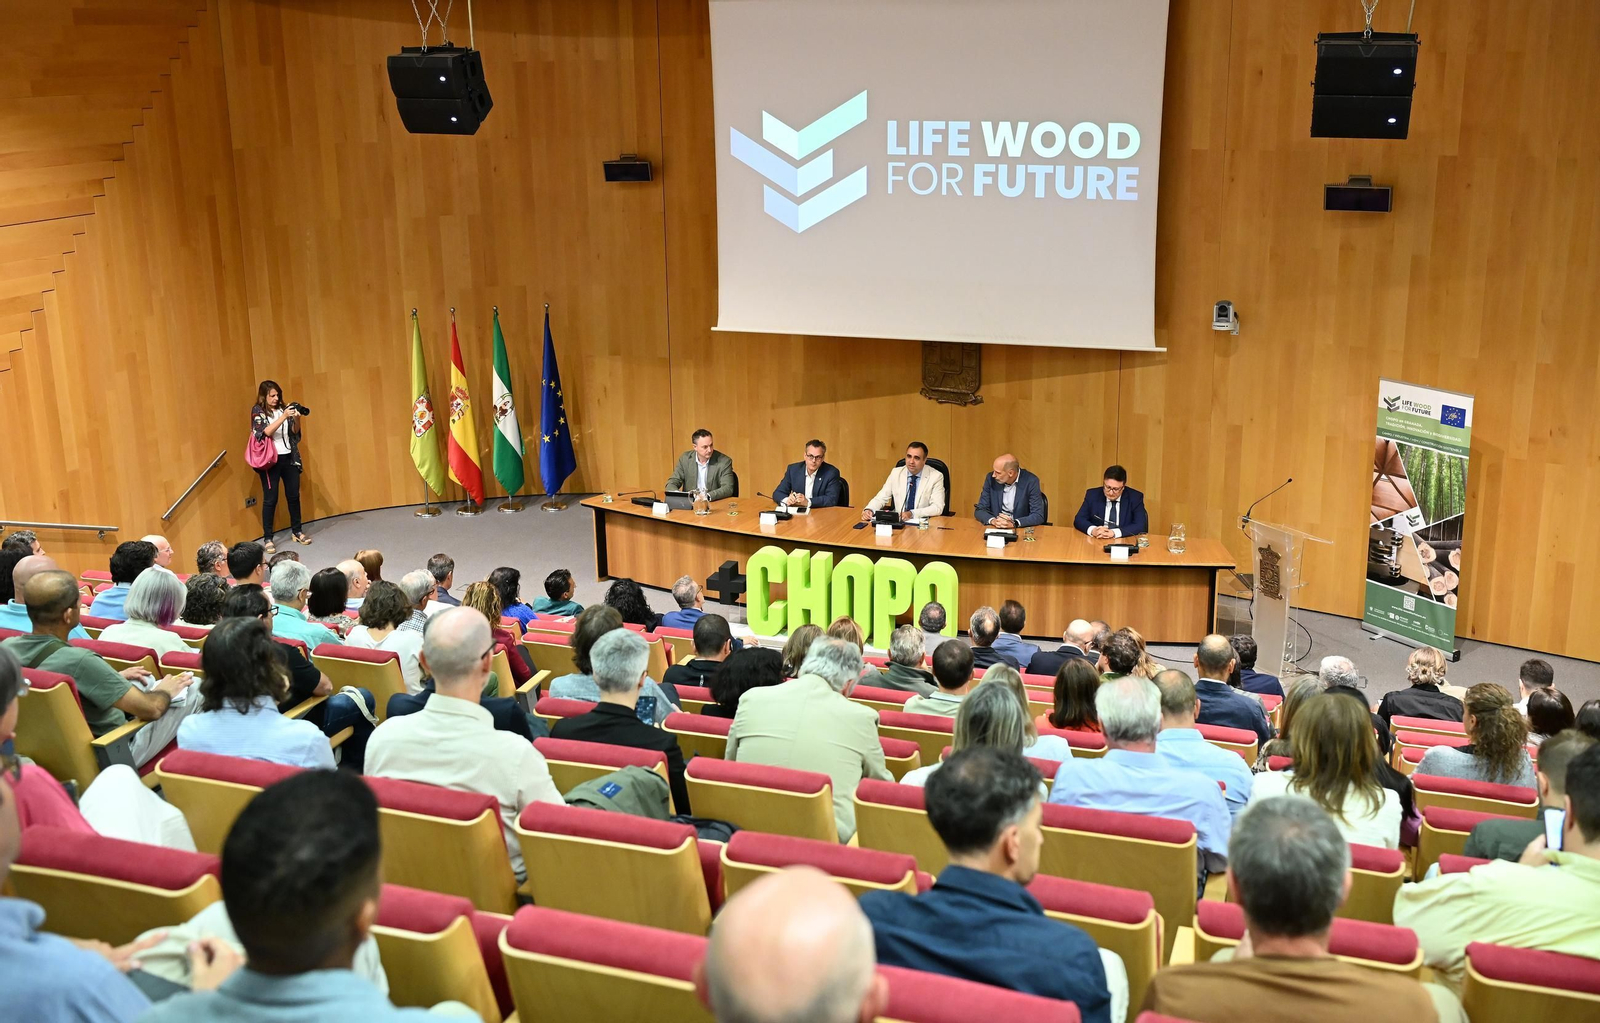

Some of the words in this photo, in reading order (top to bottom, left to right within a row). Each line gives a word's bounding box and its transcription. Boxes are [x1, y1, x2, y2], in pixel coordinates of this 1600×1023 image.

[887, 120, 970, 156] LIFE
[981, 121, 1141, 160] WOOD
[887, 161, 964, 197] FOR
[973, 163, 1139, 201] FUTURE
[1412, 408, 1431, 416] FUTURE
[1413, 402, 1432, 410] WOOD
